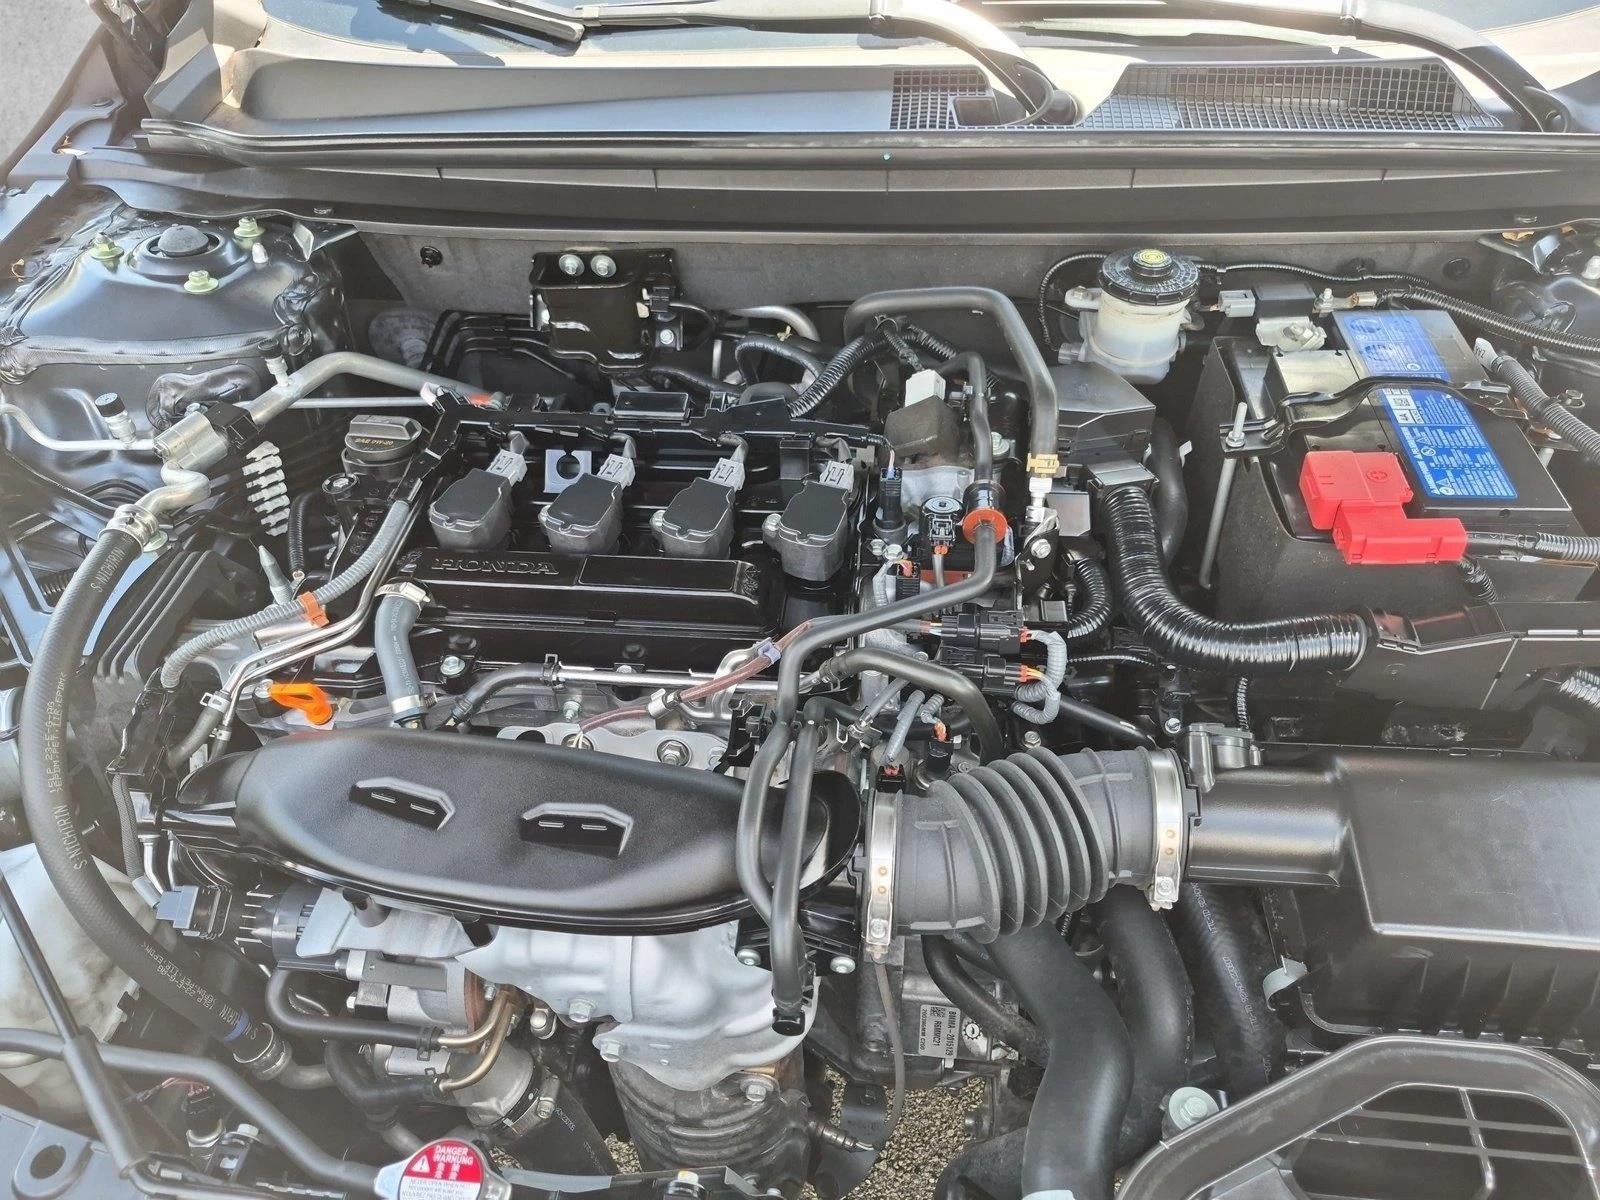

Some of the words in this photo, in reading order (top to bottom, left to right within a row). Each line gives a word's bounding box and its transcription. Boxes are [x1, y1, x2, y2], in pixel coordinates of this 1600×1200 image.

[431, 558, 560, 575] HONDA
[435, 1145, 469, 1156] DANGER
[433, 1153, 474, 1166] WARNUNG
